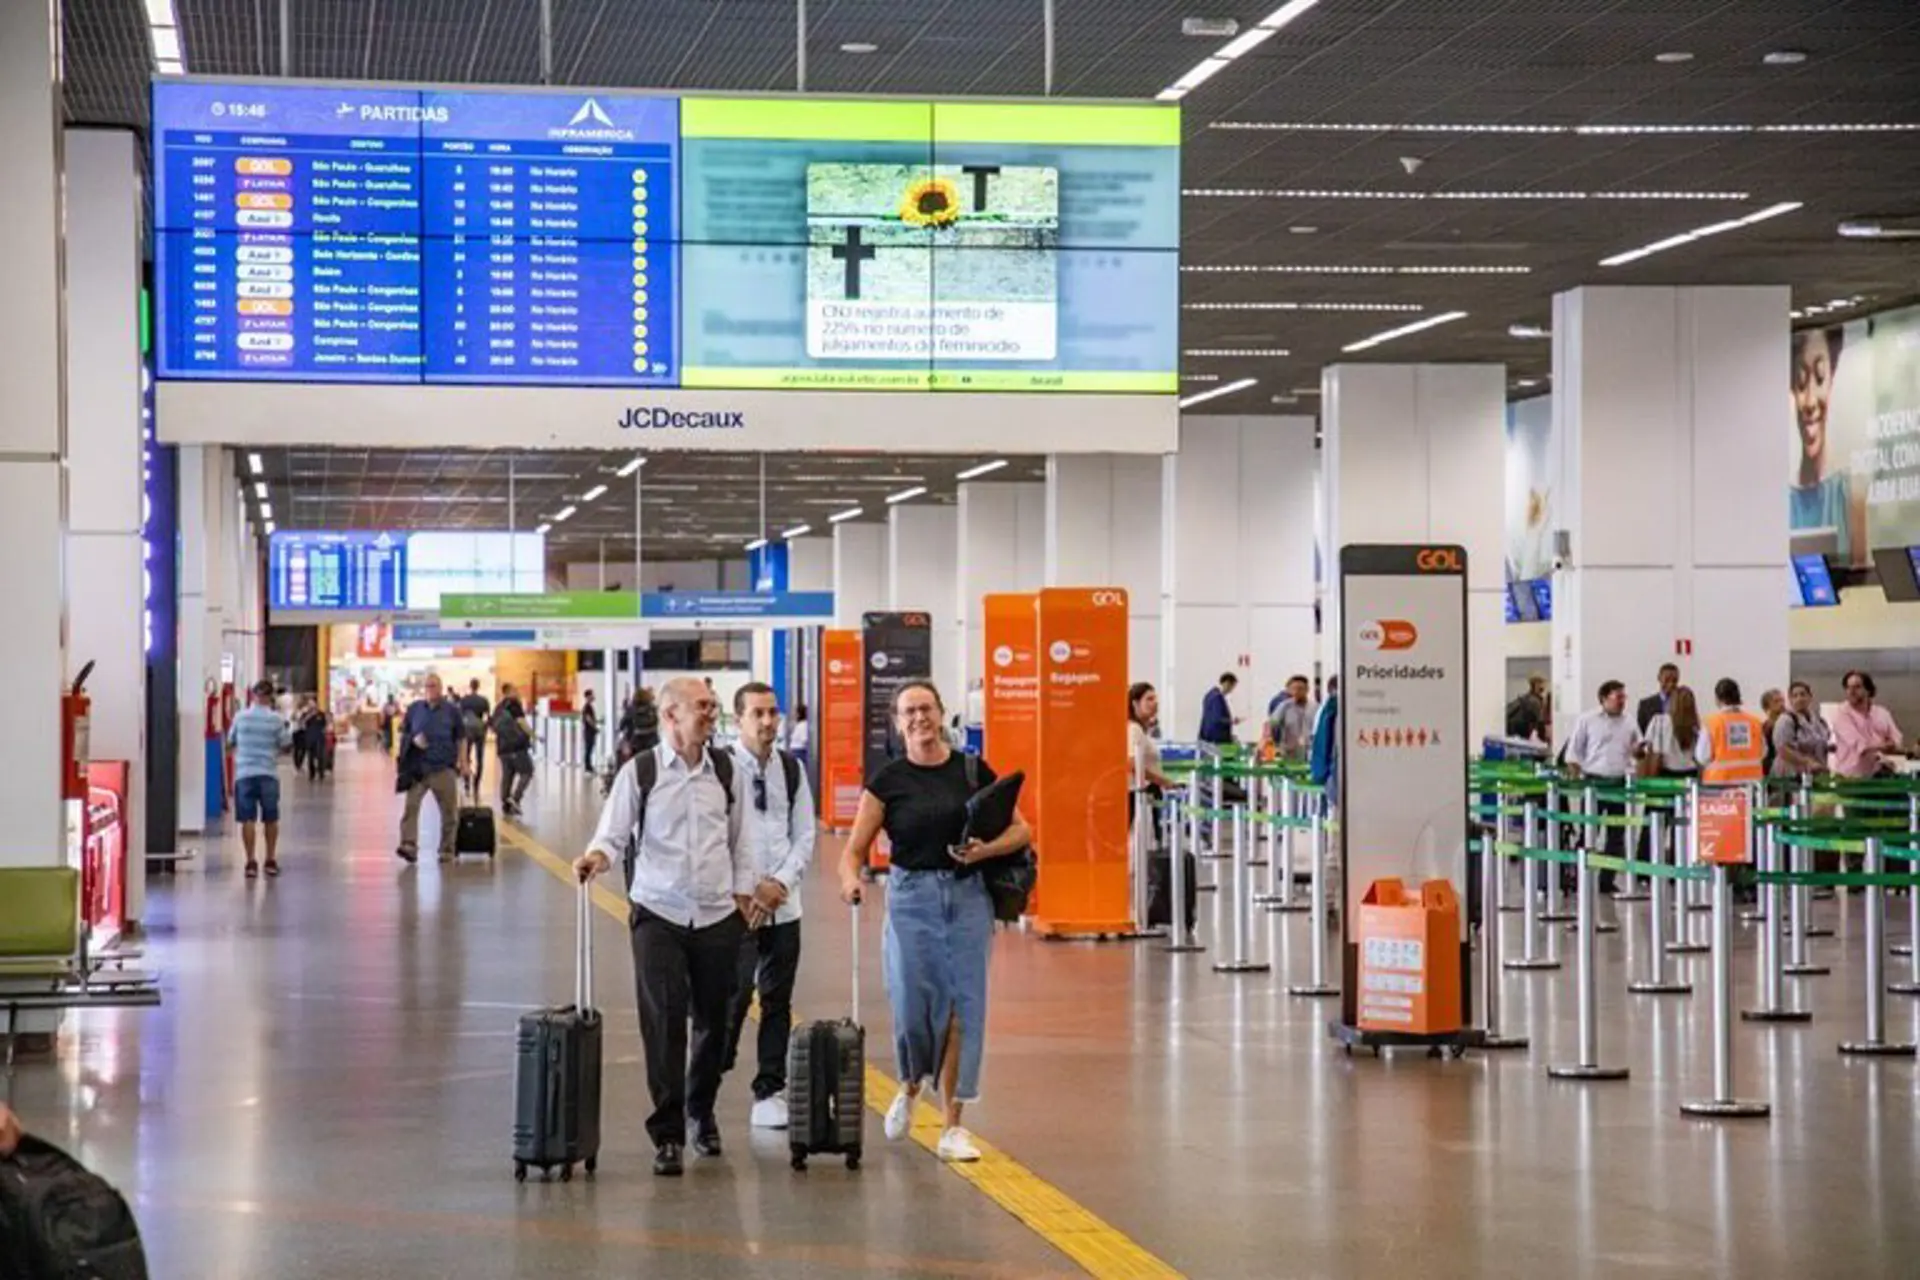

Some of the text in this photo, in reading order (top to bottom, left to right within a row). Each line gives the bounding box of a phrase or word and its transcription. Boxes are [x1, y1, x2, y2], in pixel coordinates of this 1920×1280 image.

[360, 104, 450, 123] PARTIDAS
[855, 305, 911, 321] registra
[913, 306, 980, 319] aumento
[984, 305, 1004, 320] de
[864, 324, 882, 335] no
[949, 321, 970, 335] de
[821, 337, 911, 353] julgamentos
[914, 338, 934, 352] de
[618, 407, 744, 429] JCDecaux
[1416, 549, 1463, 570] GOL
[1092, 591, 1124, 607] GOL
[1051, 672, 1100, 686] Bagagem
[1356, 664, 1445, 680] Prioridades
